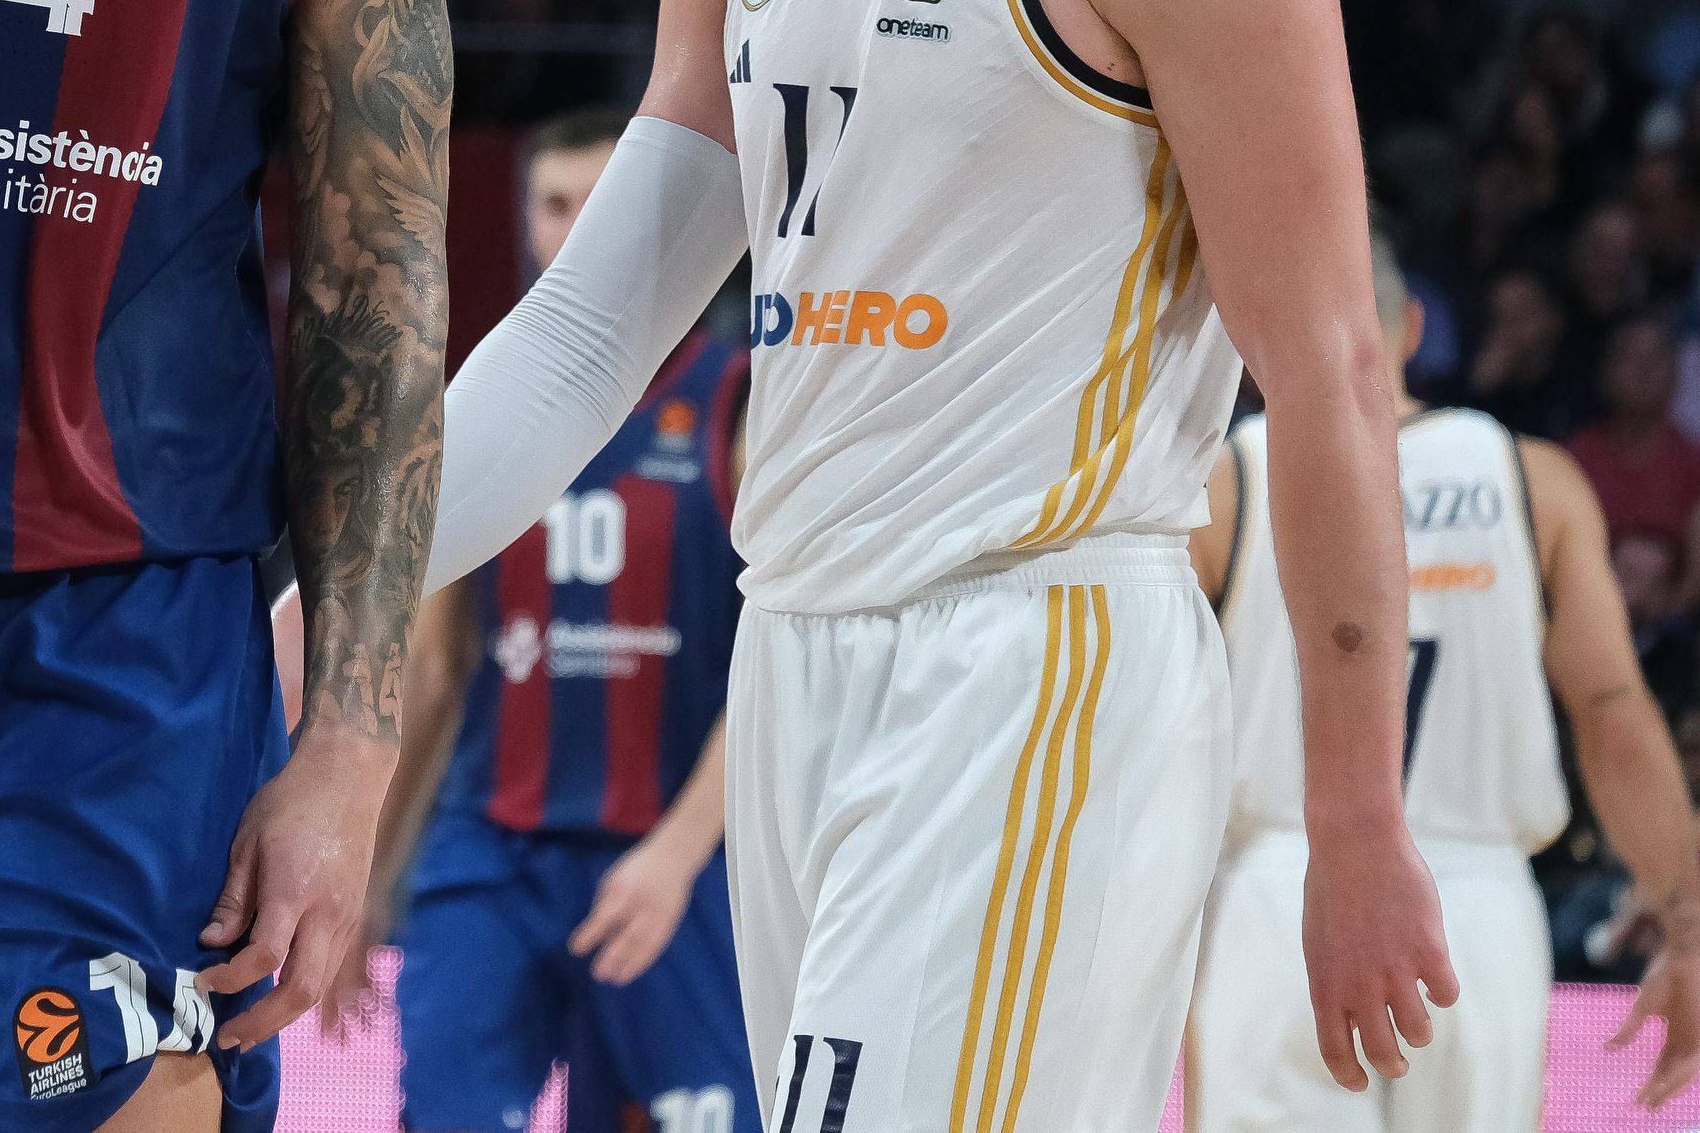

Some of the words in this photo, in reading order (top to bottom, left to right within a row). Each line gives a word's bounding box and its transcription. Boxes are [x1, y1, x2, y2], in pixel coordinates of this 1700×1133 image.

[877, 17, 949, 41] oneteam
[545, 492, 626, 582] 10
[28, 1053, 82, 1083] TURKISH
[31, 1065, 84, 1096] AIRLINES
